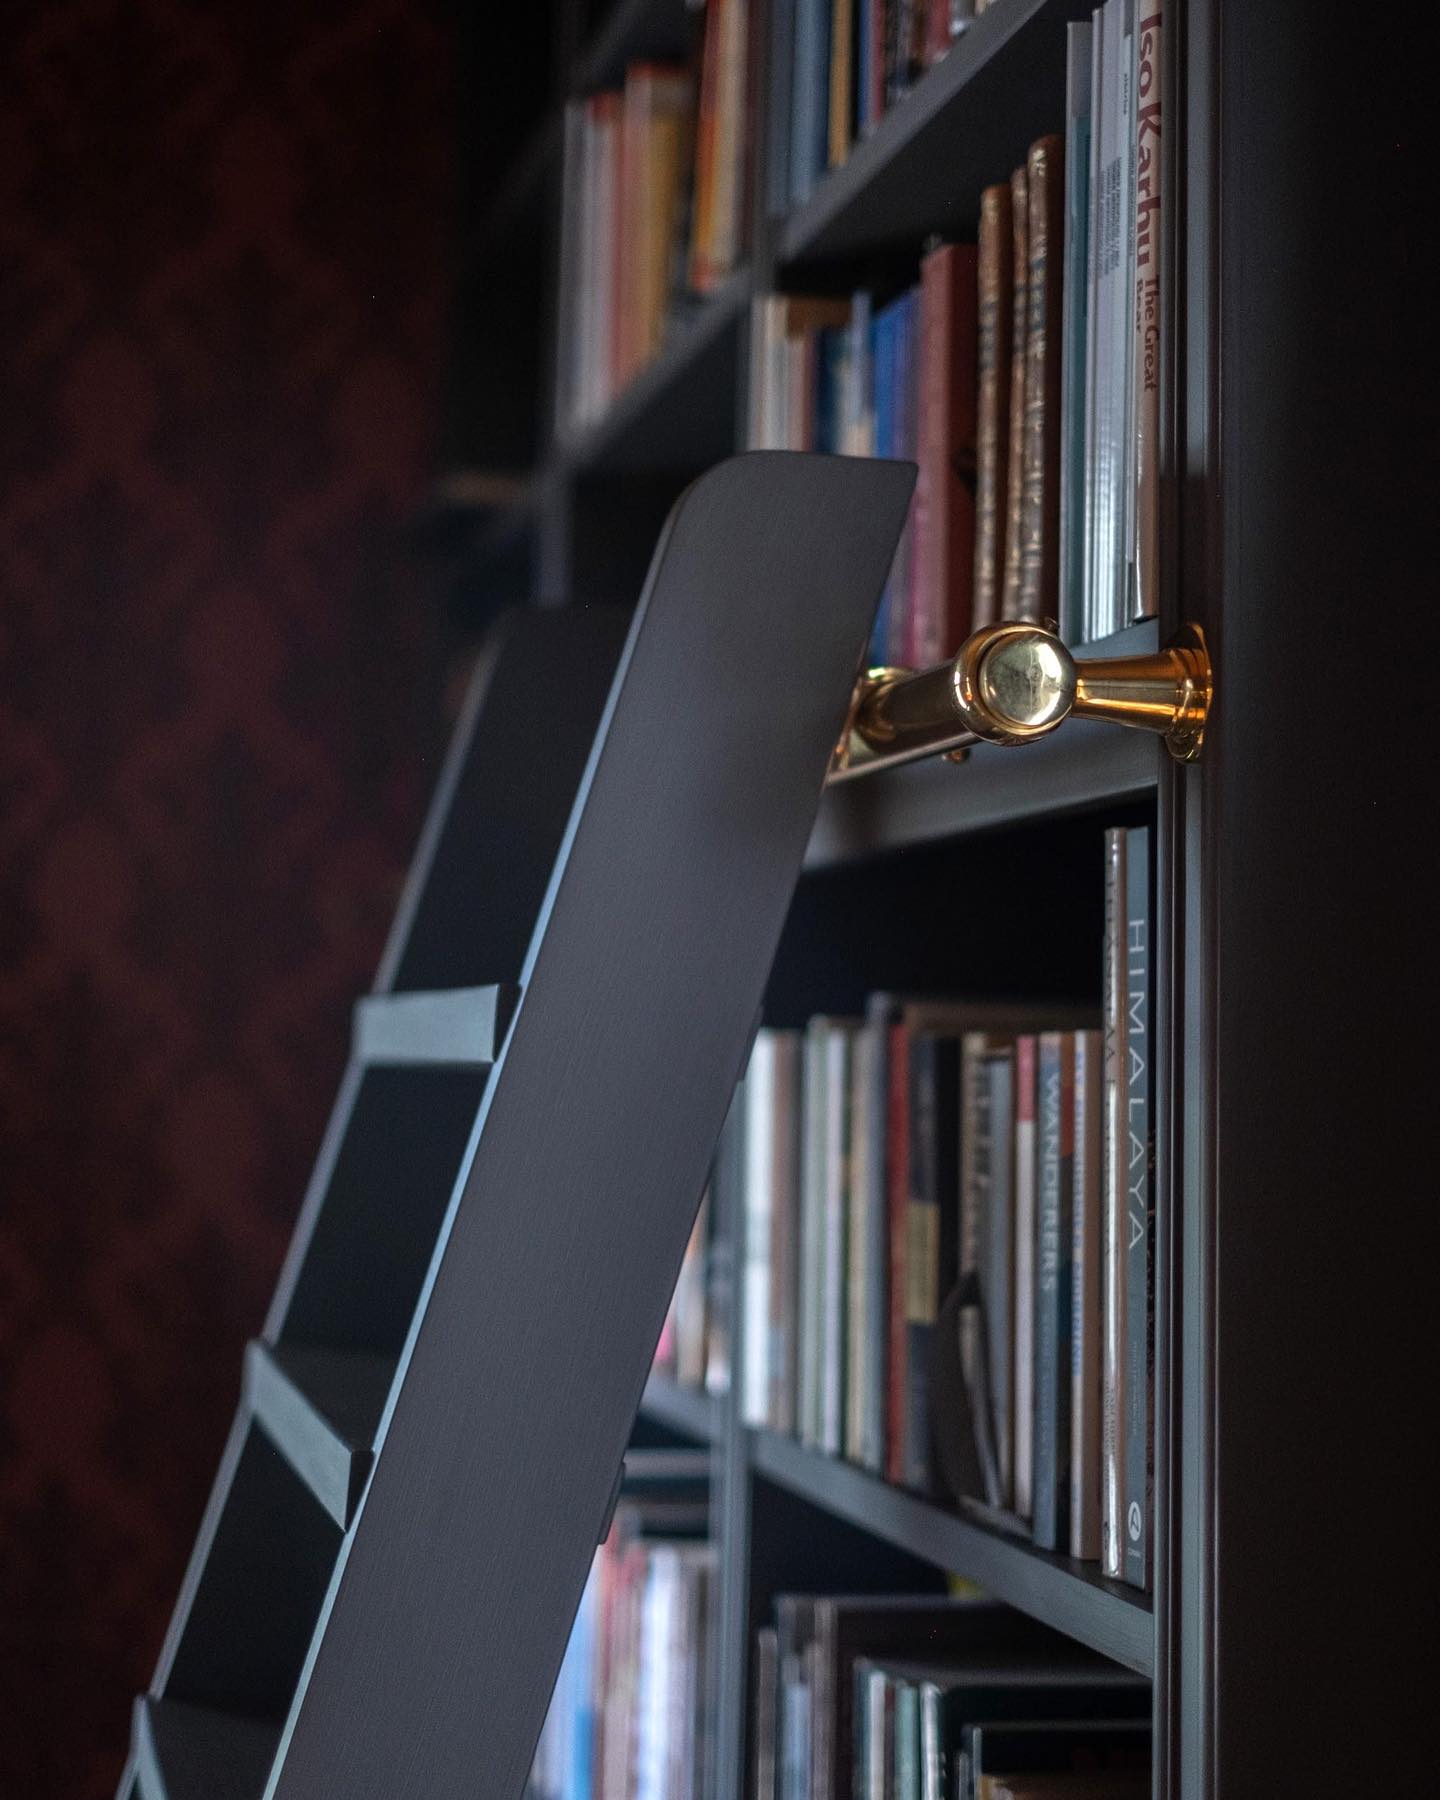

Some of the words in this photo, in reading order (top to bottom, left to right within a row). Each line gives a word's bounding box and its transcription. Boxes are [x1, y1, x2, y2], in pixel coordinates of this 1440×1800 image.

[1138, 12, 1162, 98] Iso
[1137, 101, 1162, 267] Karhu
[1144, 274, 1161, 321] The
[1144, 324, 1161, 392] Great
[1128, 919, 1146, 1249] HIMALAYA
[1042, 1071, 1060, 1291] WANDERERS
